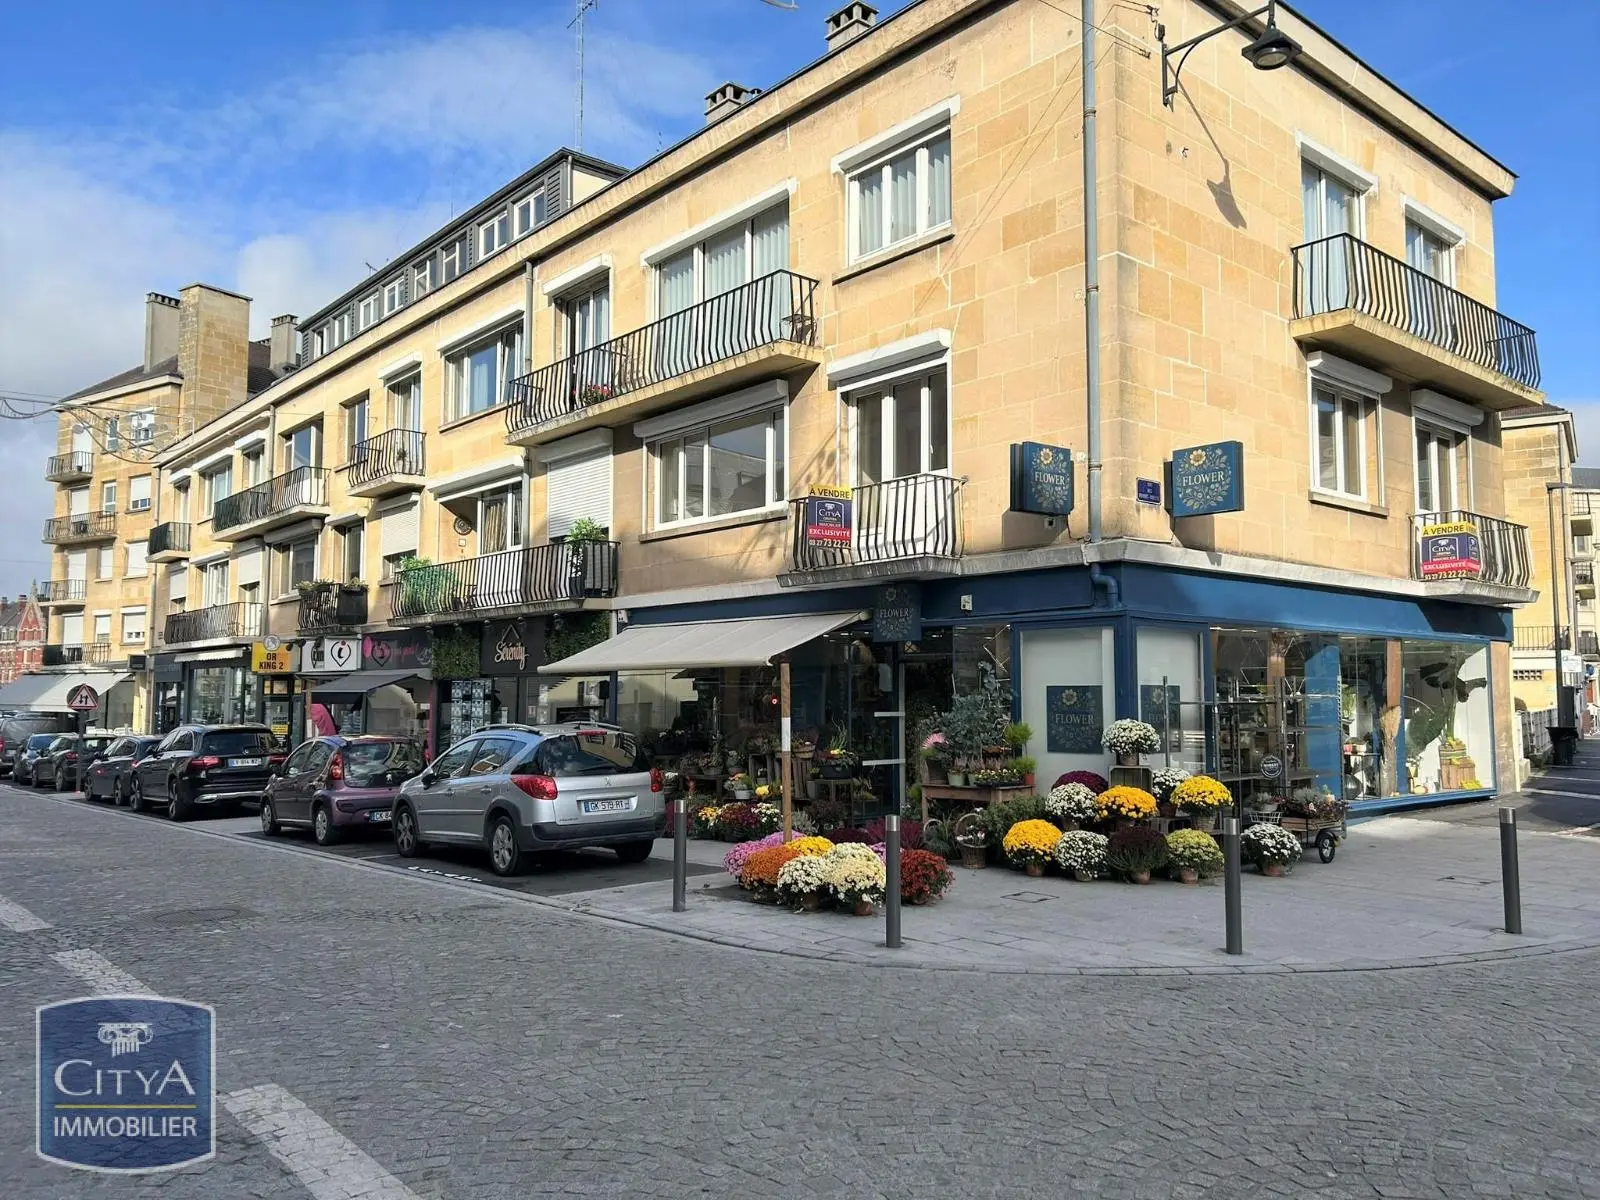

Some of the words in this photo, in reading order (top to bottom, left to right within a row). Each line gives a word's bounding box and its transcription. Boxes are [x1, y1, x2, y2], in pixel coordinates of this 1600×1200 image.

[1035, 471, 1065, 485] FLOWER
[1182, 470, 1224, 487] FLOWER
[817, 487, 850, 499] VENDRE
[1430, 524, 1464, 535] VENDRE
[823, 538, 832, 547] 73
[833, 539, 841, 548] 22
[1438, 571, 1447, 579] 73
[1447, 570, 1457, 578] 22
[1457, 569, 1467, 577] 22
[879, 607, 909, 618] FLOWER
[266, 652, 277, 661] OR
[258, 661, 277, 670] KING
[278, 661, 284, 670] 2
[1055, 713, 1095, 725] FLOWER
